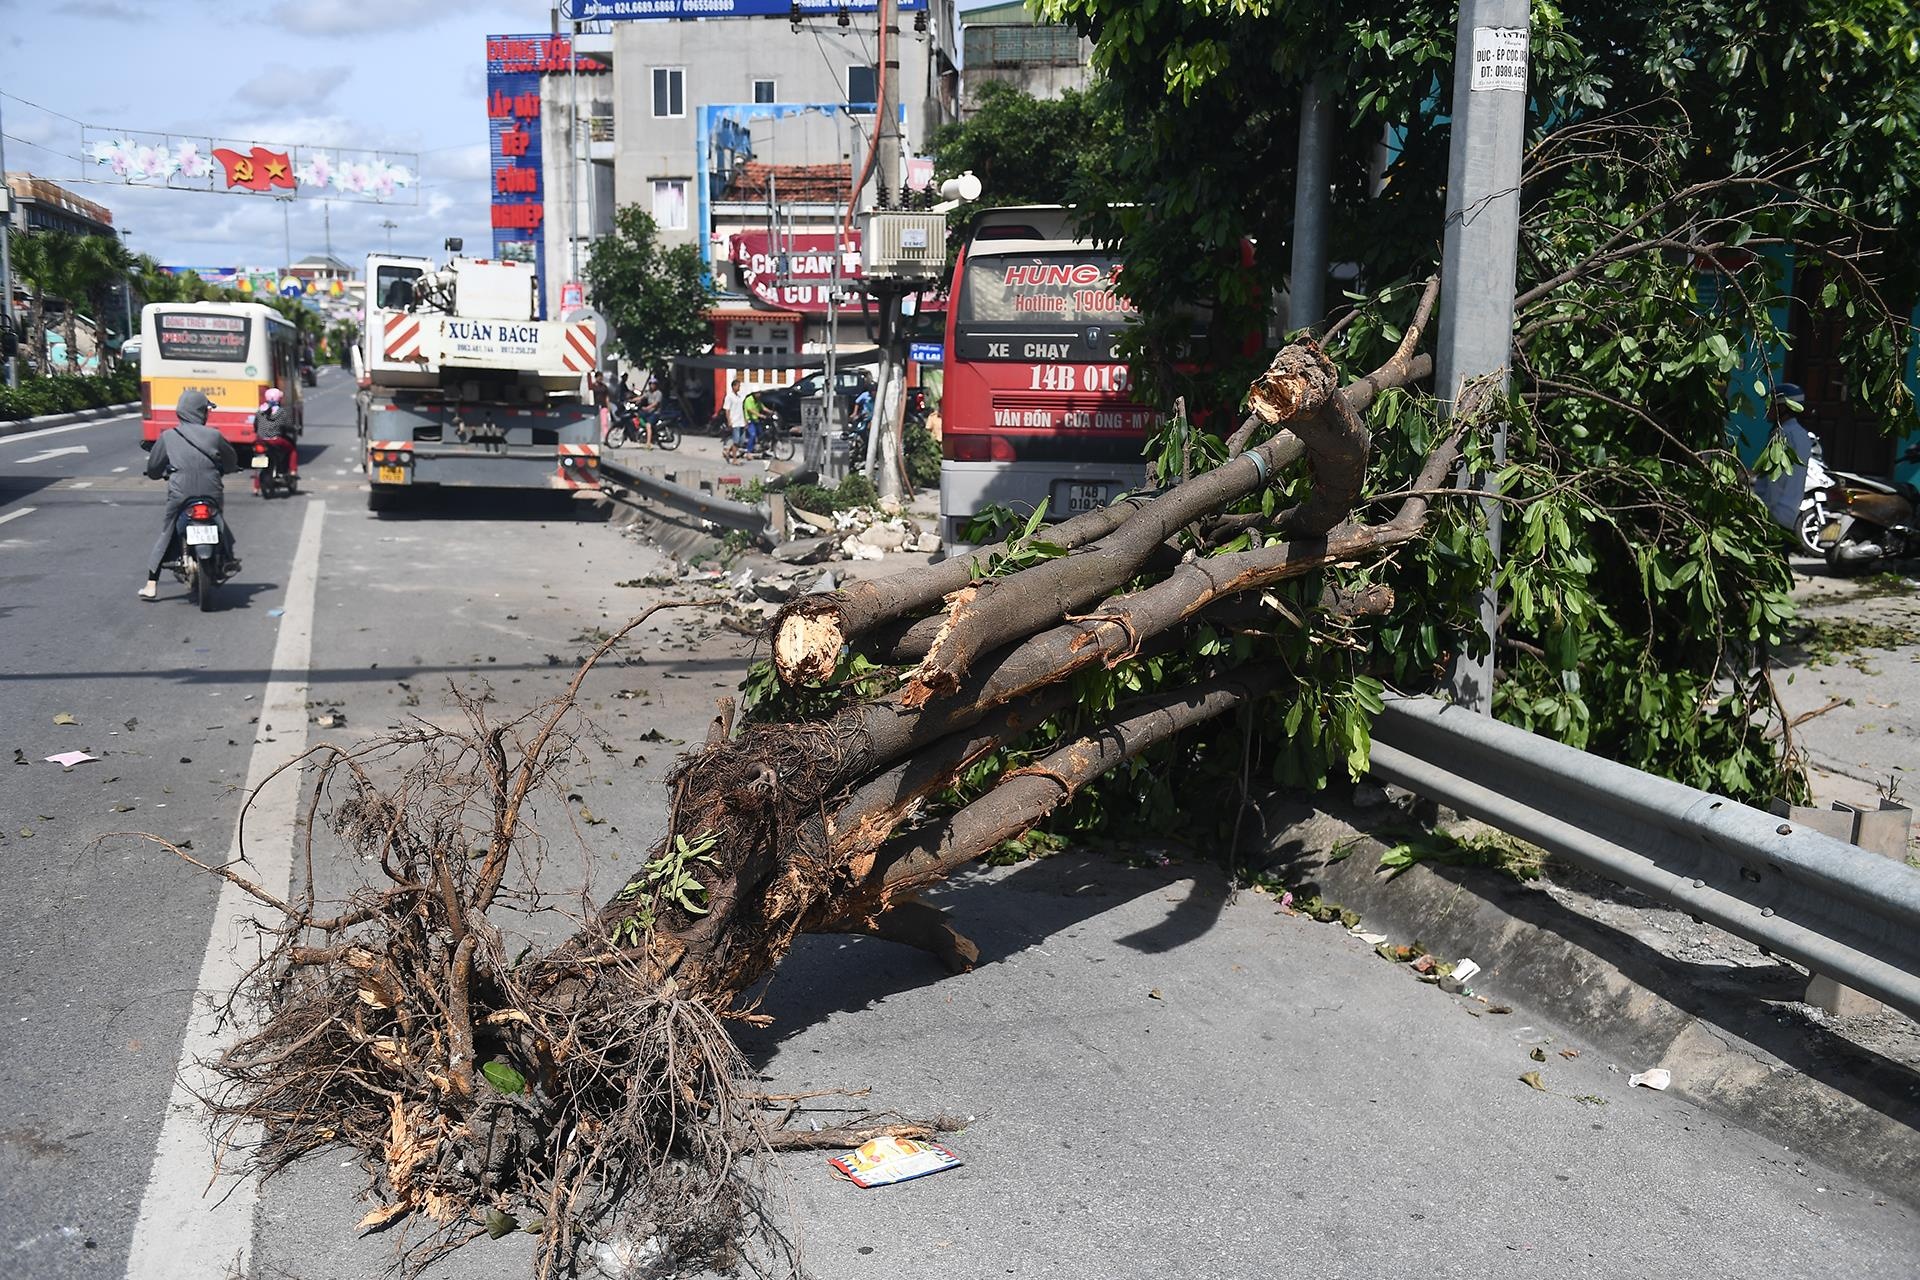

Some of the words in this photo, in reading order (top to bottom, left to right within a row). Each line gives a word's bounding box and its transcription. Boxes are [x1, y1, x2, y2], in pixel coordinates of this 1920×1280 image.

[496, 164, 536, 192] CÔNG
[490, 197, 543, 235] NGHIỆP
[1004, 258, 1100, 287] HÙNG
[1015, 293, 1068, 312] Hotline:
[449, 320, 492, 340] XUÂN
[499, 325, 538, 343] BÁCH
[988, 343, 1010, 358] XE
[1024, 343, 1070, 360] CHẠY
[1029, 364, 1075, 391] 14B
[1084, 364, 1133, 392] 019.
[994, 409, 1020, 427] VÂN
[1064, 409, 1091, 428] CỬA
[1095, 411, 1122, 428] ÔNG
[1080, 486, 1099, 498] 14B
